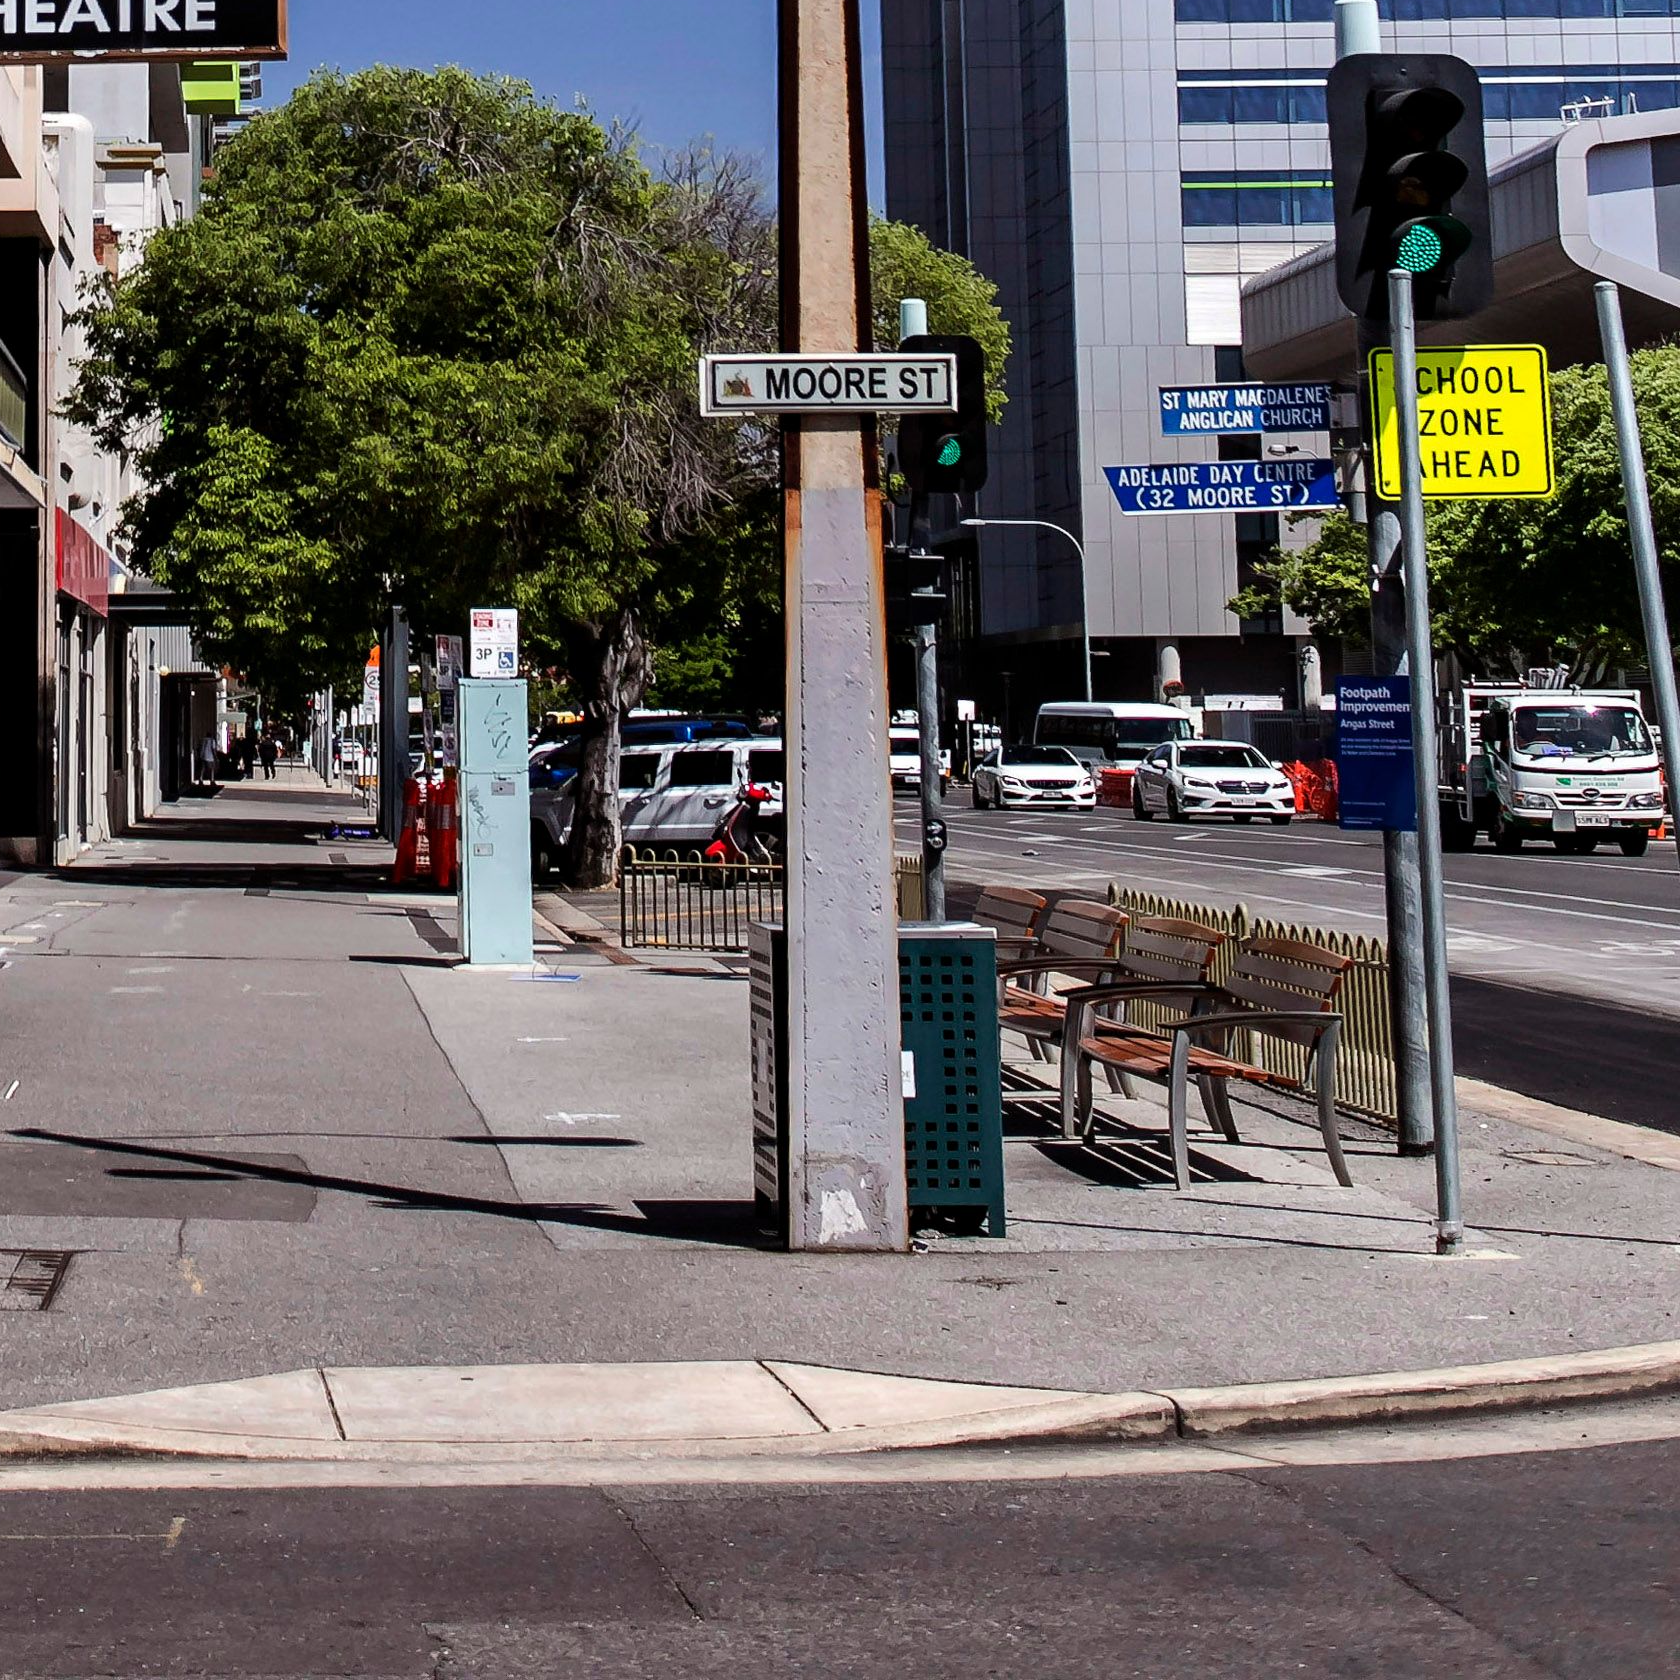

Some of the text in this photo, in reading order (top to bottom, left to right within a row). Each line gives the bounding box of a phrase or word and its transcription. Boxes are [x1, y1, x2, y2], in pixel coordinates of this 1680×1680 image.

[766, 367, 938, 400] MOORE ST
[1415, 366, 1525, 394] CHOOL
[1162, 392, 1180, 410] ST
[1187, 390, 1228, 409] MARY
[1180, 408, 1322, 430] ANGLICAN CHURCH
[1418, 409, 1503, 436] ZONE
[1118, 463, 1316, 487] ADELAIDE DAY CENTRE
[1136, 488, 1174, 510] (32
[1188, 487, 1257, 508] MOORE
[476, 648, 492, 660] 3P
[1340, 686, 1390, 700] Footpath
[1340, 701, 1411, 714] Improvemen
[1340, 718, 1395, 731] Angas Street
